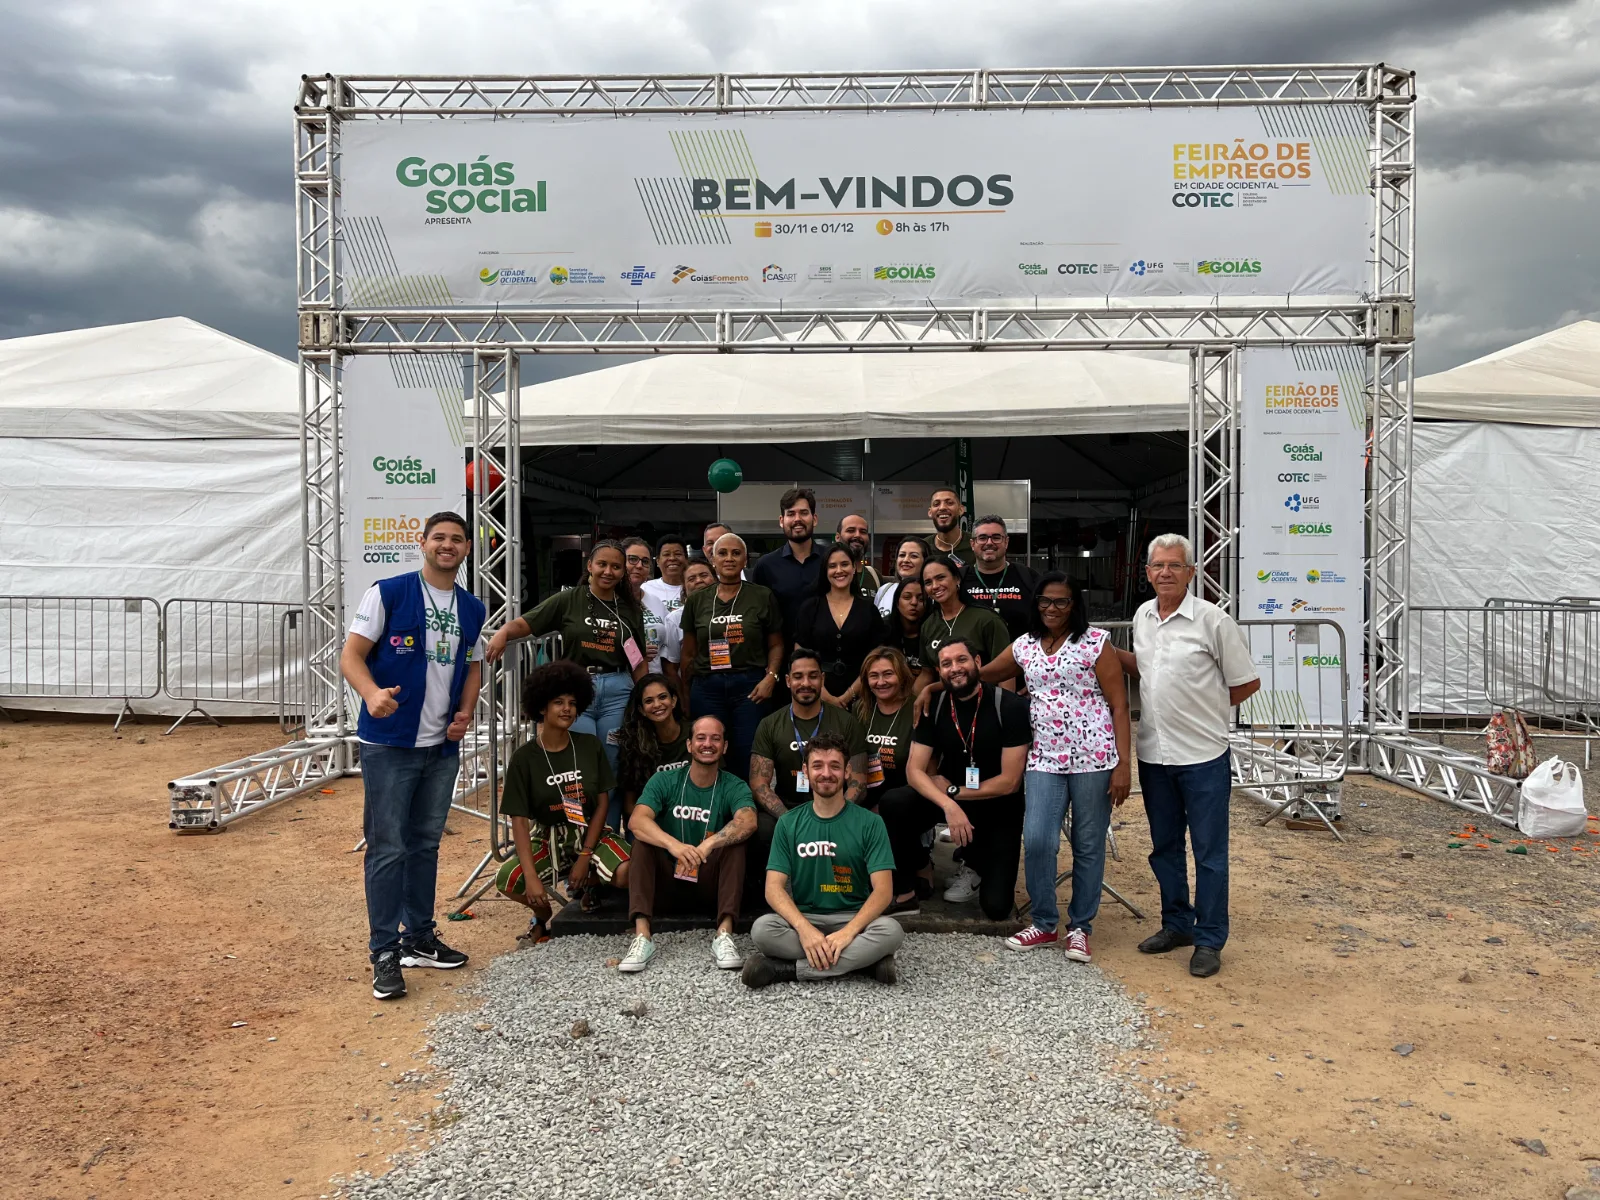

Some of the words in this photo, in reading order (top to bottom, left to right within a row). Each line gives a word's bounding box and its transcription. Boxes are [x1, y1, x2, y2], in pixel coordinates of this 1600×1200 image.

[1173, 138, 1269, 161] FEIRÃO
[1276, 142, 1311, 161] DE
[396, 155, 515, 188] Goiás
[1173, 162, 1311, 179] EMPREGOS
[1174, 182, 1188, 190] EM
[1190, 182, 1224, 190] CIDADE
[1226, 181, 1280, 190] OCIDENTAL
[425, 181, 547, 214] social
[692, 174, 1014, 211] BEM-VINDOS
[1172, 192, 1234, 208] COTEC
[424, 216, 472, 225] APRESENTA
[895, 222, 910, 233] 8h
[912, 222, 927, 233] às
[929, 221, 950, 233] 17h
[774, 223, 808, 236] 30/11
[810, 225, 818, 234] e
[820, 222, 854, 235] 01/12
[886, 264, 936, 279] GOIÁS
[1057, 263, 1098, 275] COTEC
[1209, 258, 1262, 274] GOIÁS
[500, 269, 525, 277] CIDADE
[620, 271, 656, 280] SEBRAE
[500, 276, 537, 284] OCIDENTAL
[1265, 382, 1317, 397] FEIRÃO
[1320, 385, 1339, 396] DE
[1265, 397, 1339, 408] EMPREGOS
[1283, 443, 1314, 453] Goiás
[1290, 451, 1323, 461] social
[372, 455, 422, 472] Goiás
[385, 468, 436, 484] social
[1277, 473, 1310, 483] COTEC
[363, 514, 420, 531] FEIRÃO
[1297, 522, 1332, 534] GOIÁS
[363, 531, 422, 544] EMPREG
[363, 552, 400, 563] COTEC
[711, 614, 743, 624] COTEC
[1311, 655, 1341, 666] GOIÁ
[867, 734, 898, 746] COTEC
[546, 770, 583, 786] COTEC
[672, 805, 711, 823] COTEC
[797, 841, 837, 858] COTEC
